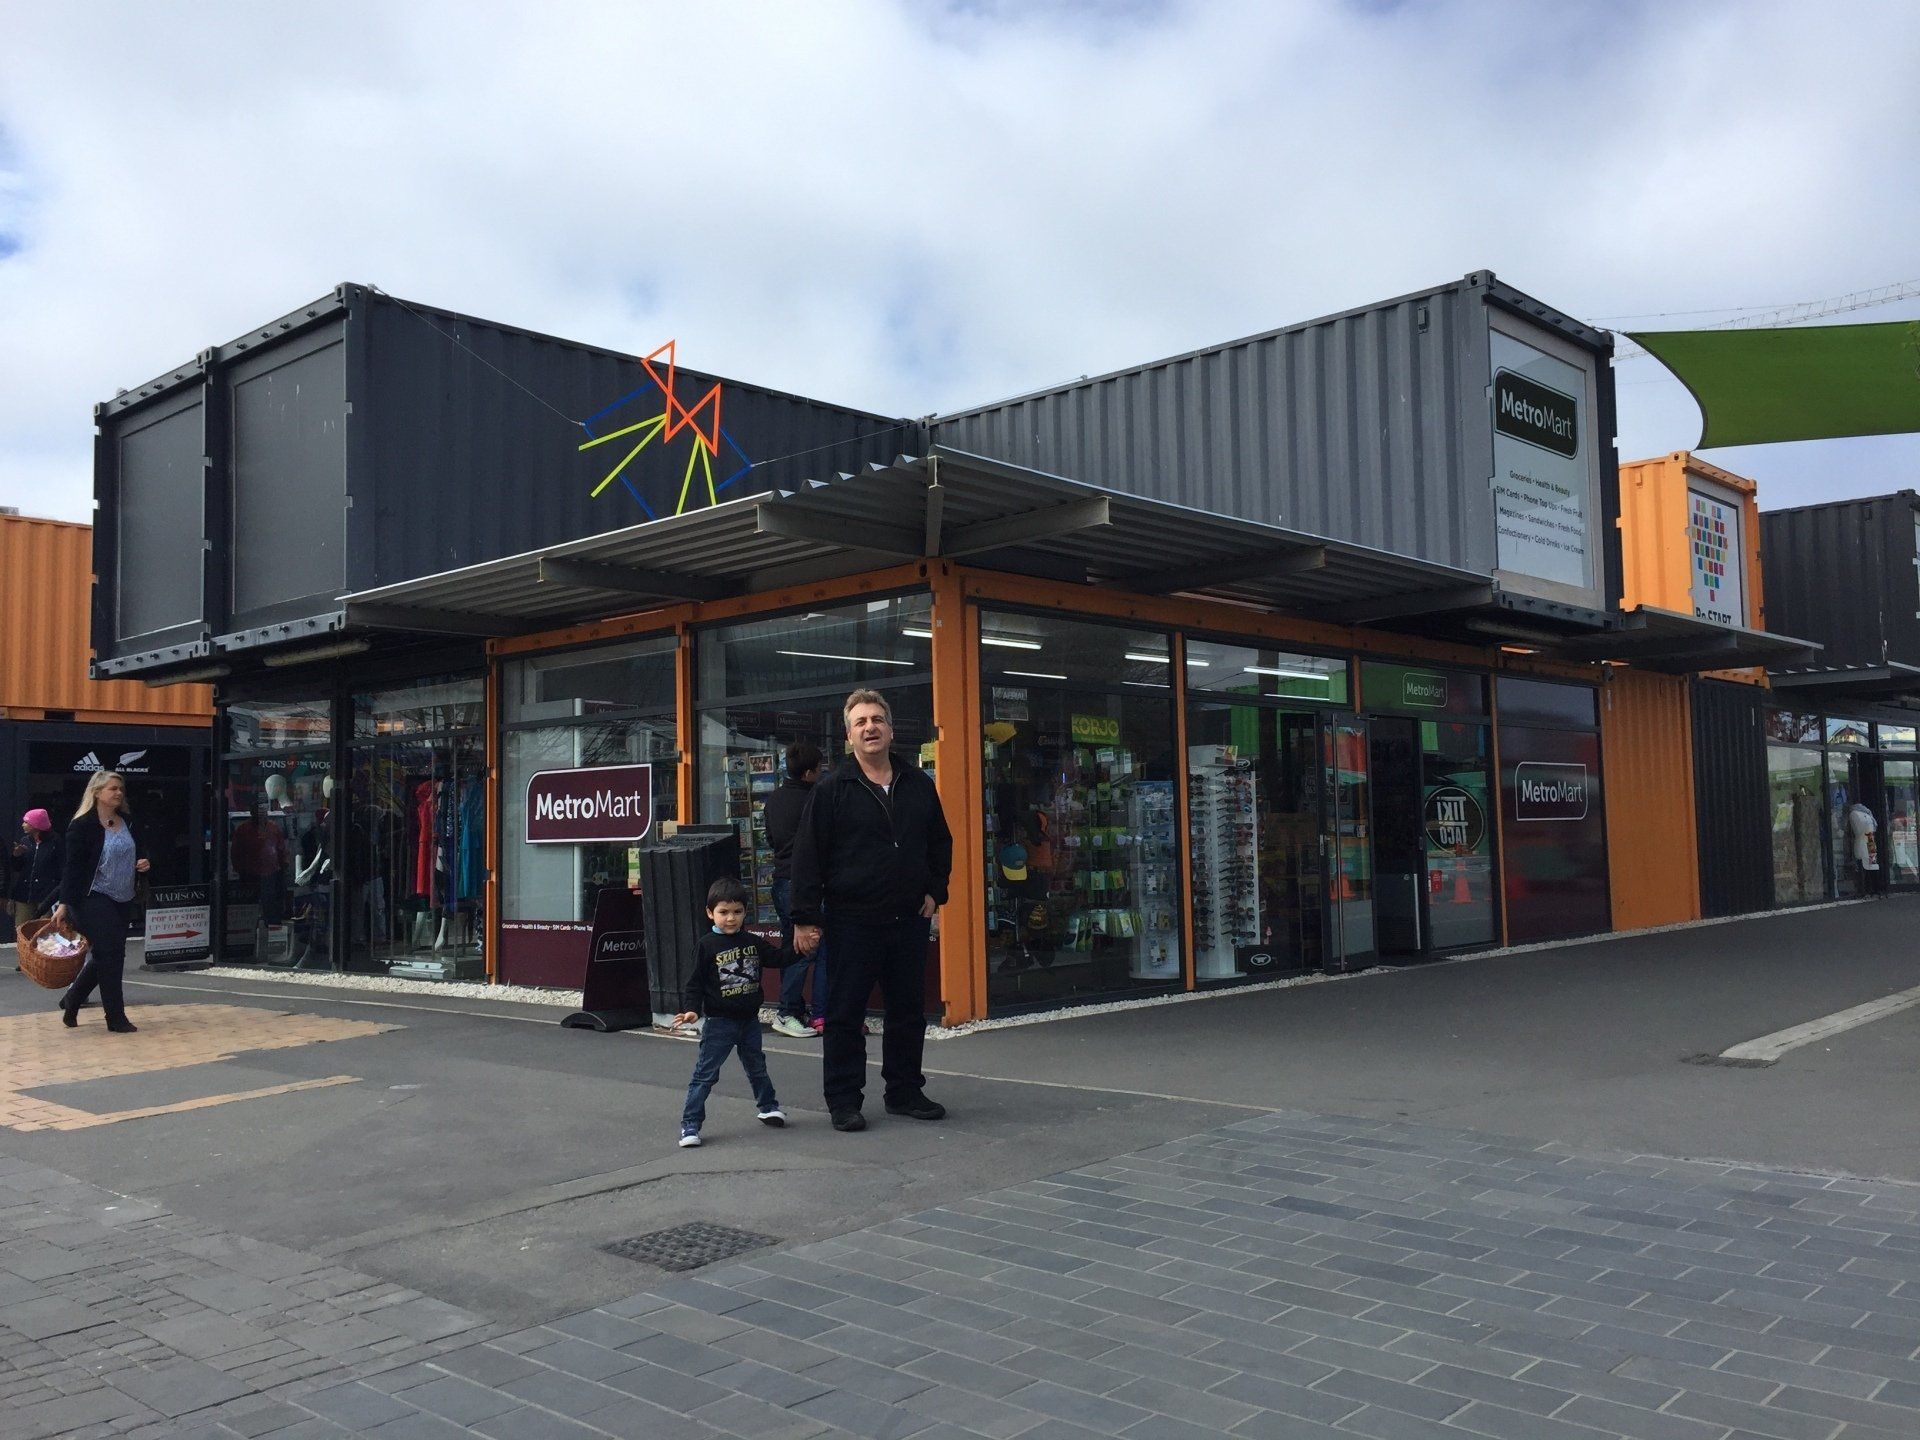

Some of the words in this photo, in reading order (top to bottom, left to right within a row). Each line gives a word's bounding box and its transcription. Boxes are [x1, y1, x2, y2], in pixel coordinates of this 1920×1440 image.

[1501, 388, 1572, 440] MetroMart
[1509, 470, 1532, 484] Groceries
[1535, 477, 1550, 490] Health
[1496, 485, 1506, 494] SIM
[1506, 489, 1520, 500] Cards
[1523, 494, 1538, 505] Phone
[1539, 498, 1547, 508] Top
[1499, 506, 1525, 520] Magazines
[1528, 514, 1555, 528] Sandwiches
[1534, 535, 1546, 545] Cold
[1546, 538, 1560, 549] Drinks
[1406, 682, 1444, 698] MetroMart
[1072, 718, 1120, 737] KORJO
[73, 764, 104, 772] adidas
[1522, 780, 1583, 803] MetroMart
[535, 789, 641, 820] MetroMart
[155, 891, 205, 901] MADISONS
[181, 912, 205, 920] STORE
[537, 923, 550, 931] Beauty
[573, 924, 586, 932] Phone
[715, 948, 741, 966] SKATE
